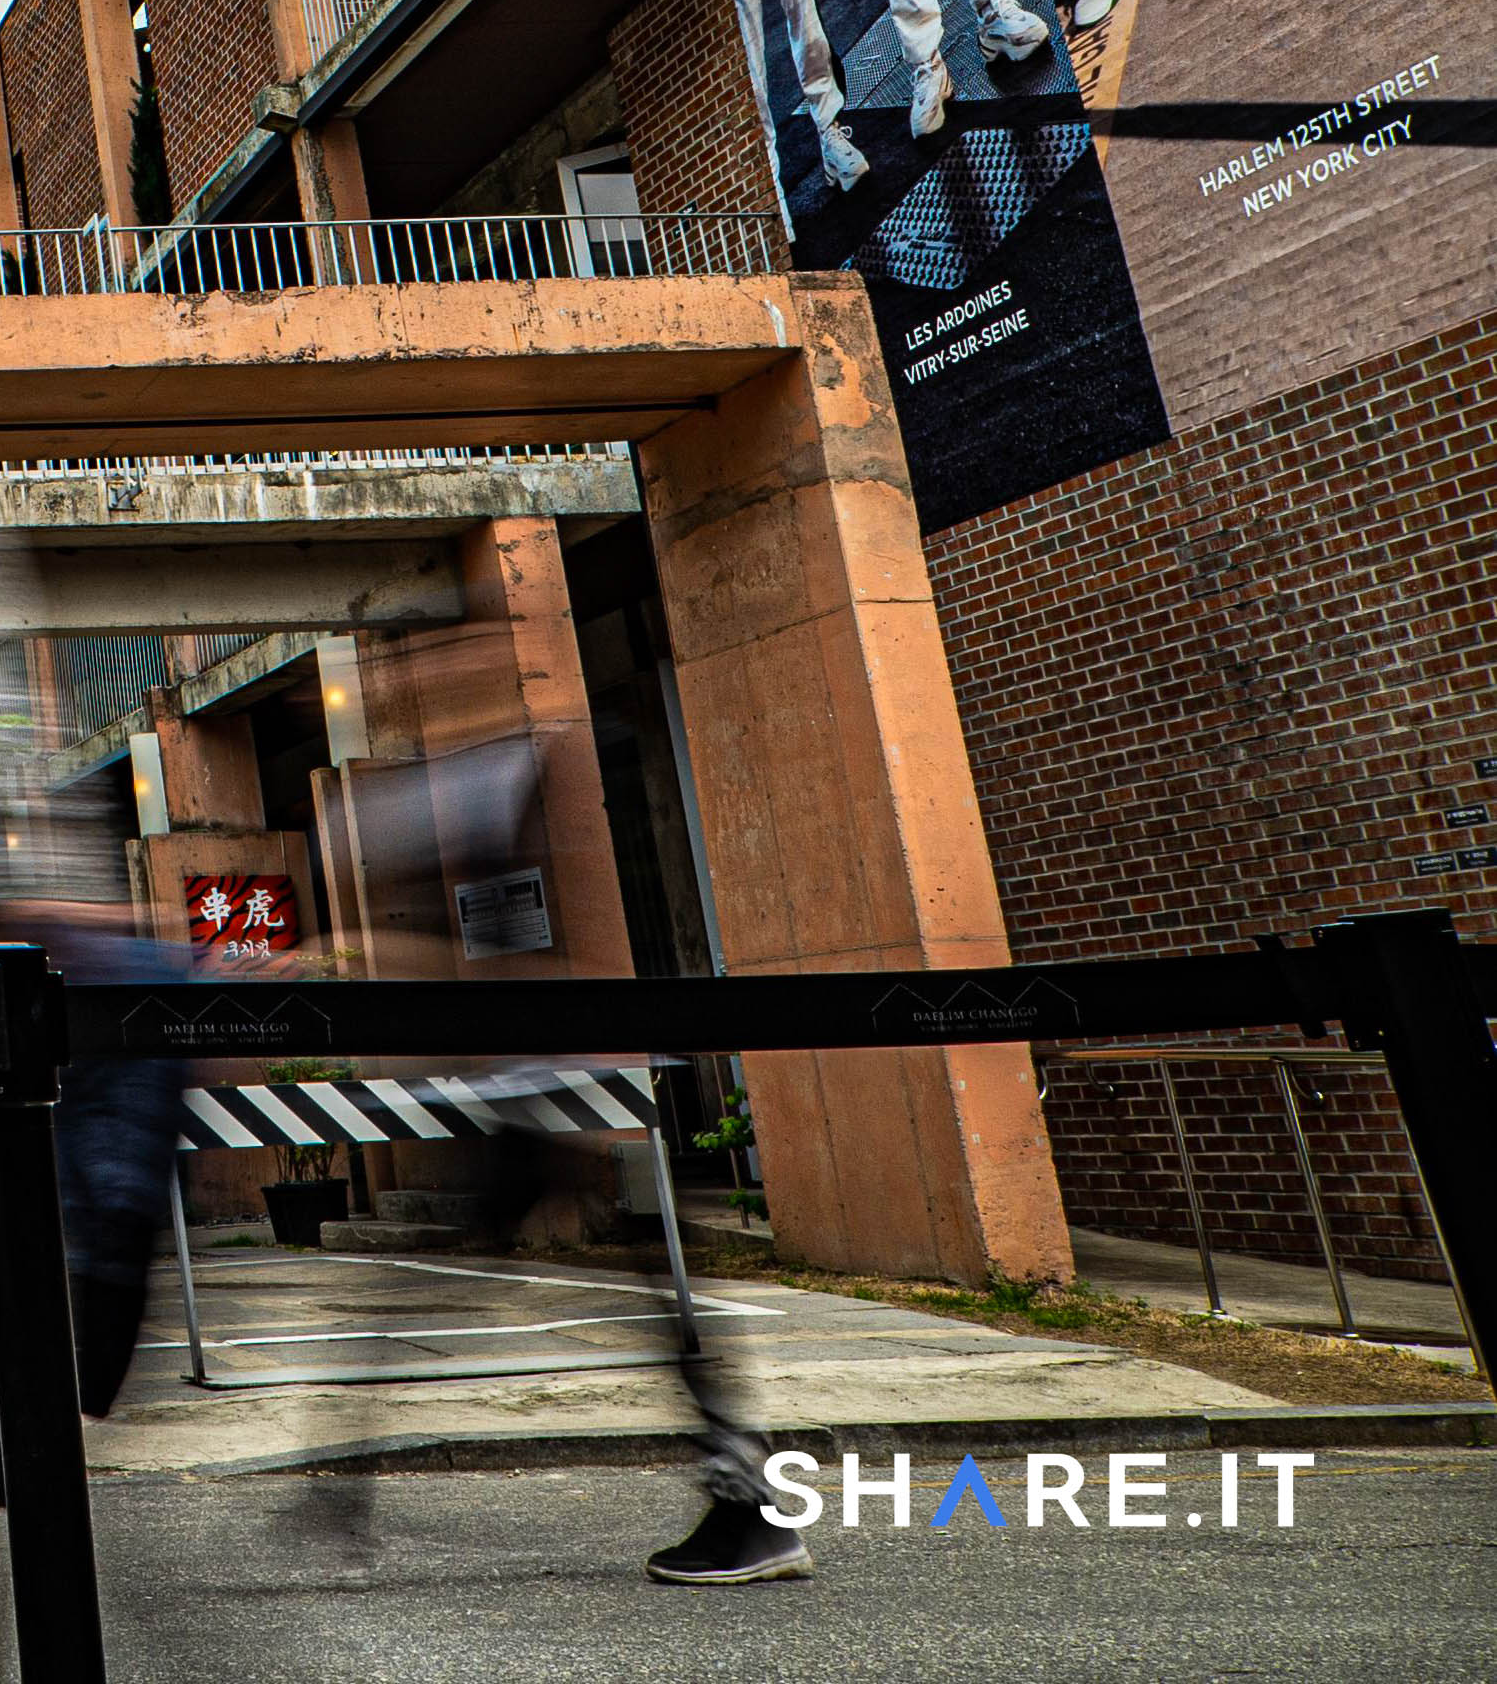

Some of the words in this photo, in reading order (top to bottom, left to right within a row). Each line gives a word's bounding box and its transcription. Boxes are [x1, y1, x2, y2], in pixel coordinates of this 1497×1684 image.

[1199, 137, 1284, 196] HARLEM
[1287, 102, 1352, 152] 125TH
[1356, 55, 1440, 117] STREET
[1243, 178, 1292, 217] NEW
[1296, 144, 1359, 189] YORK
[1362, 115, 1412, 157] CITY
[904, 308, 1030, 385] VITRY-SUR-SEINE
[906, 322, 933, 350] LES
[936, 280, 1012, 336] ARDOINES
[163, 1023, 215, 1034] DAELIM
[913, 1011, 965, 1022] DAELIM
